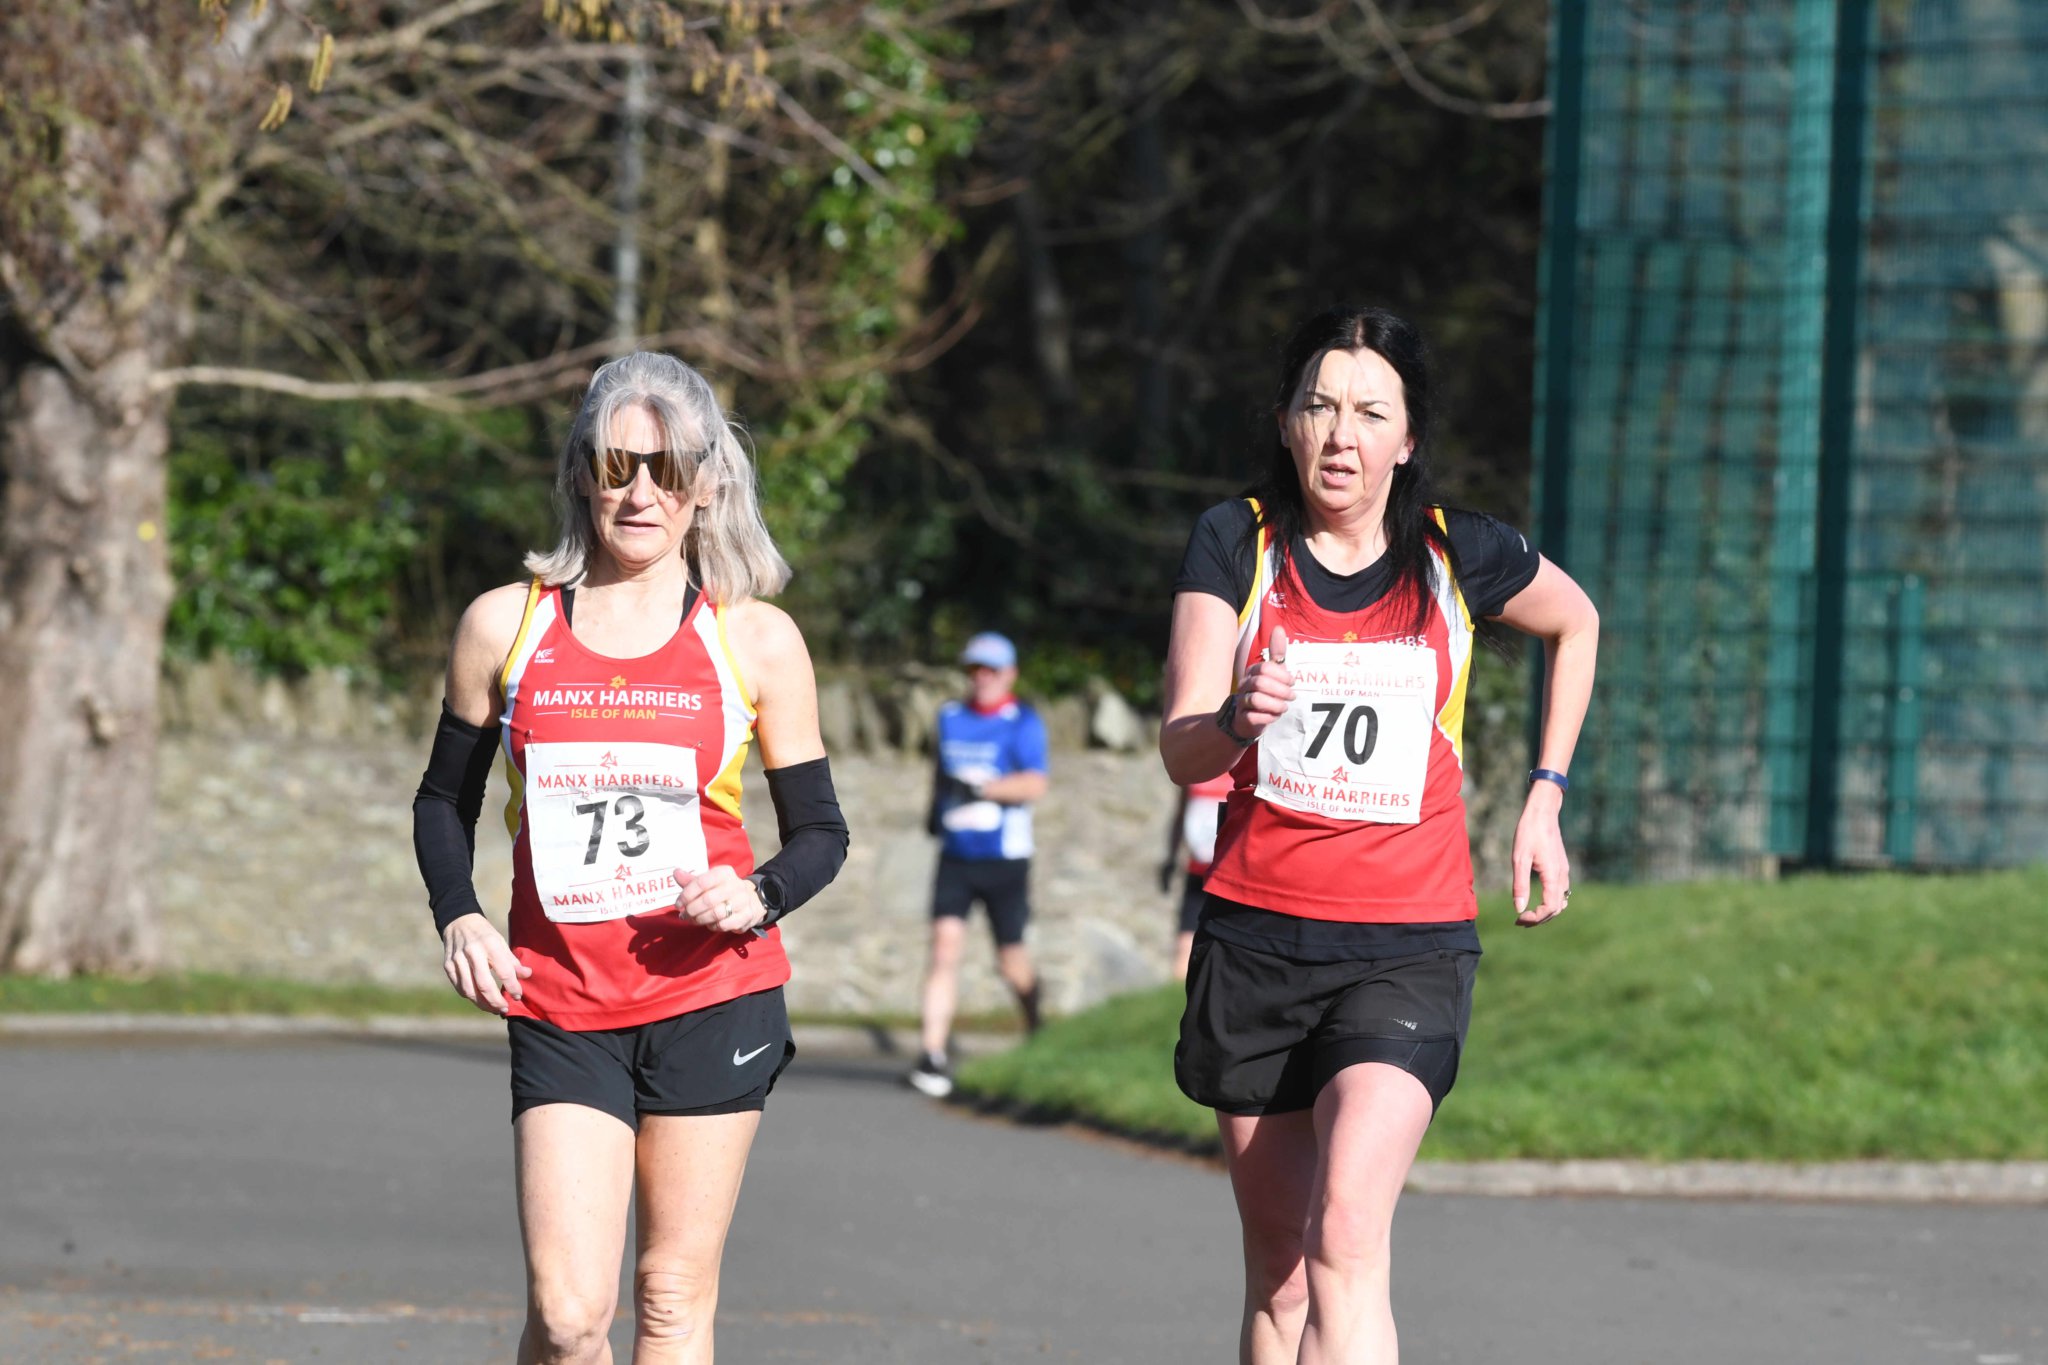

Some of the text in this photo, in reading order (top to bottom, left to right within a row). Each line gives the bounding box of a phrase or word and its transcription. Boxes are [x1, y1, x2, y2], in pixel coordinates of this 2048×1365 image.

[1293, 670, 1329, 684] ANX
[533, 690, 702, 710] MANX HARRIERS
[1321, 688, 1380, 698] ISLE OF MAN
[570, 708, 657, 720] ISLE OF MAN
[1305, 702, 1379, 765] 70
[538, 773, 684, 789] MANX HARRIERS
[1268, 772, 1411, 807] MANX HARRIERS
[1306, 800, 1365, 815] ISLE OF MAN
[576, 795, 650, 865] 73
[553, 875, 676, 907] MANX HARRIE
